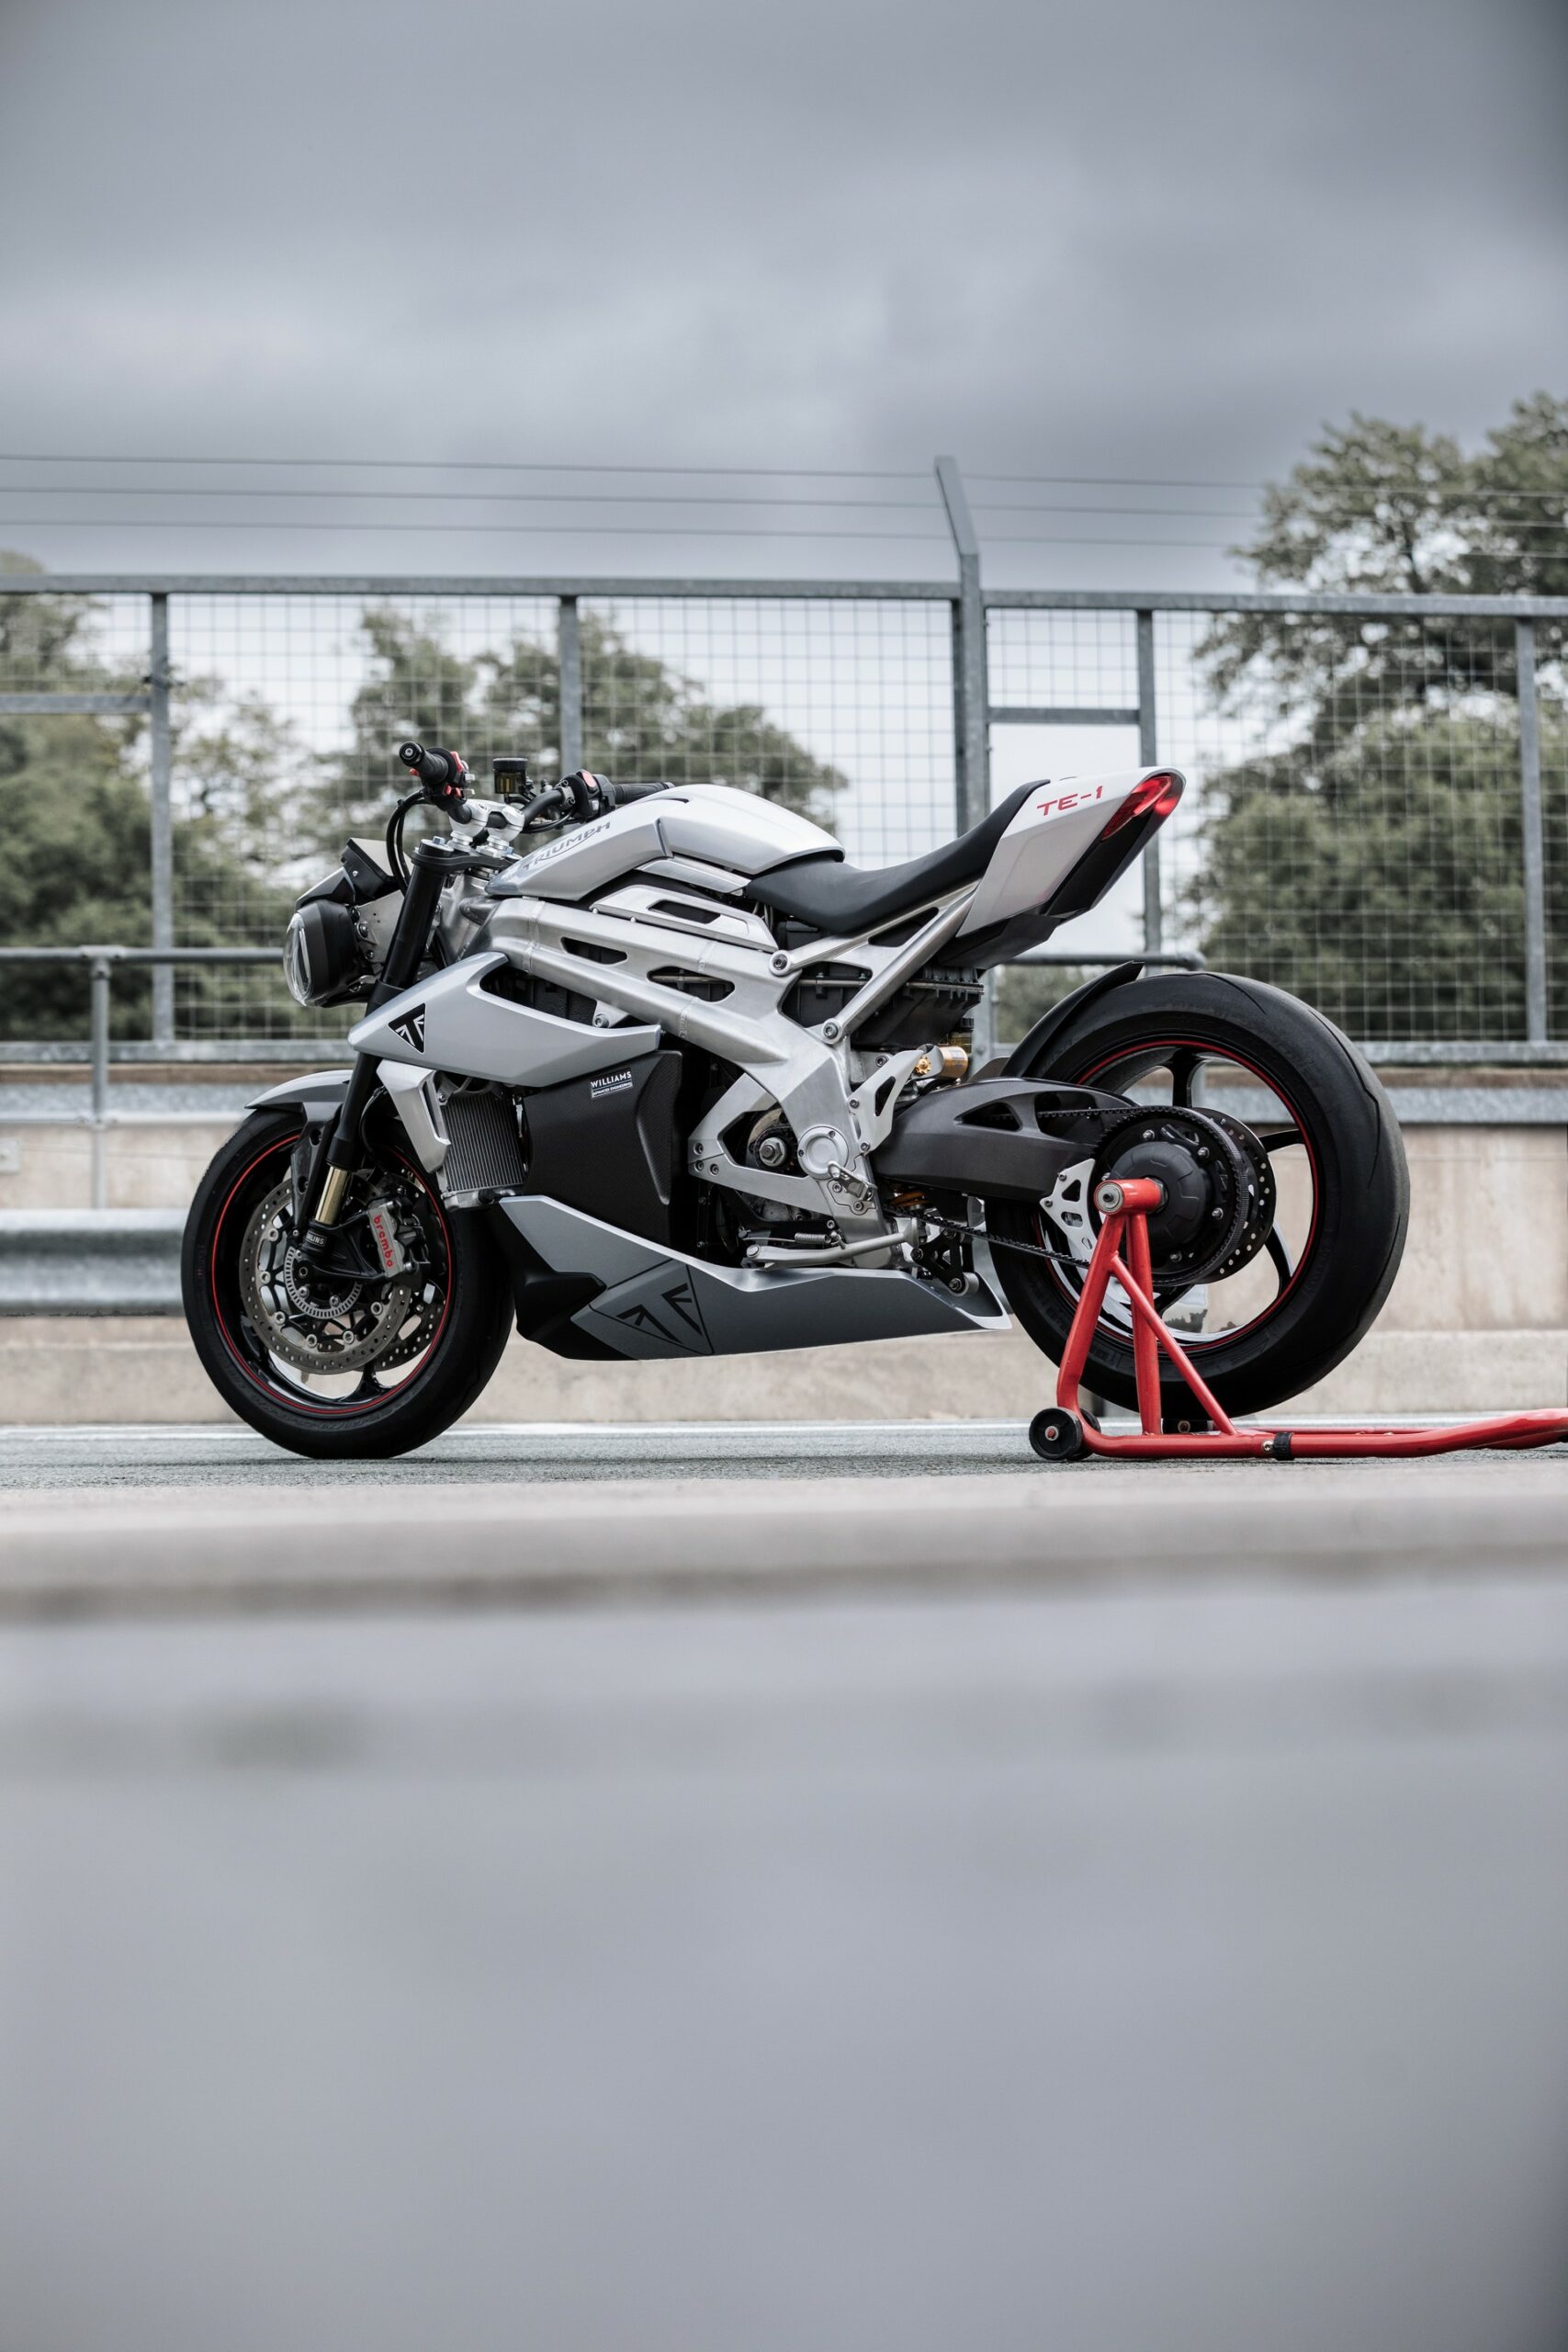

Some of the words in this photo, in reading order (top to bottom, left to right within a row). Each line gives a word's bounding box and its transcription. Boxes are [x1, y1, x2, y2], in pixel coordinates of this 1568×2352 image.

[1037, 786, 1102, 816] TE-1
[523, 821, 611, 871] TRIUMPH
[591, 1071, 632, 1088] WILLIAMS
[373, 1215, 393, 1267] brembo
